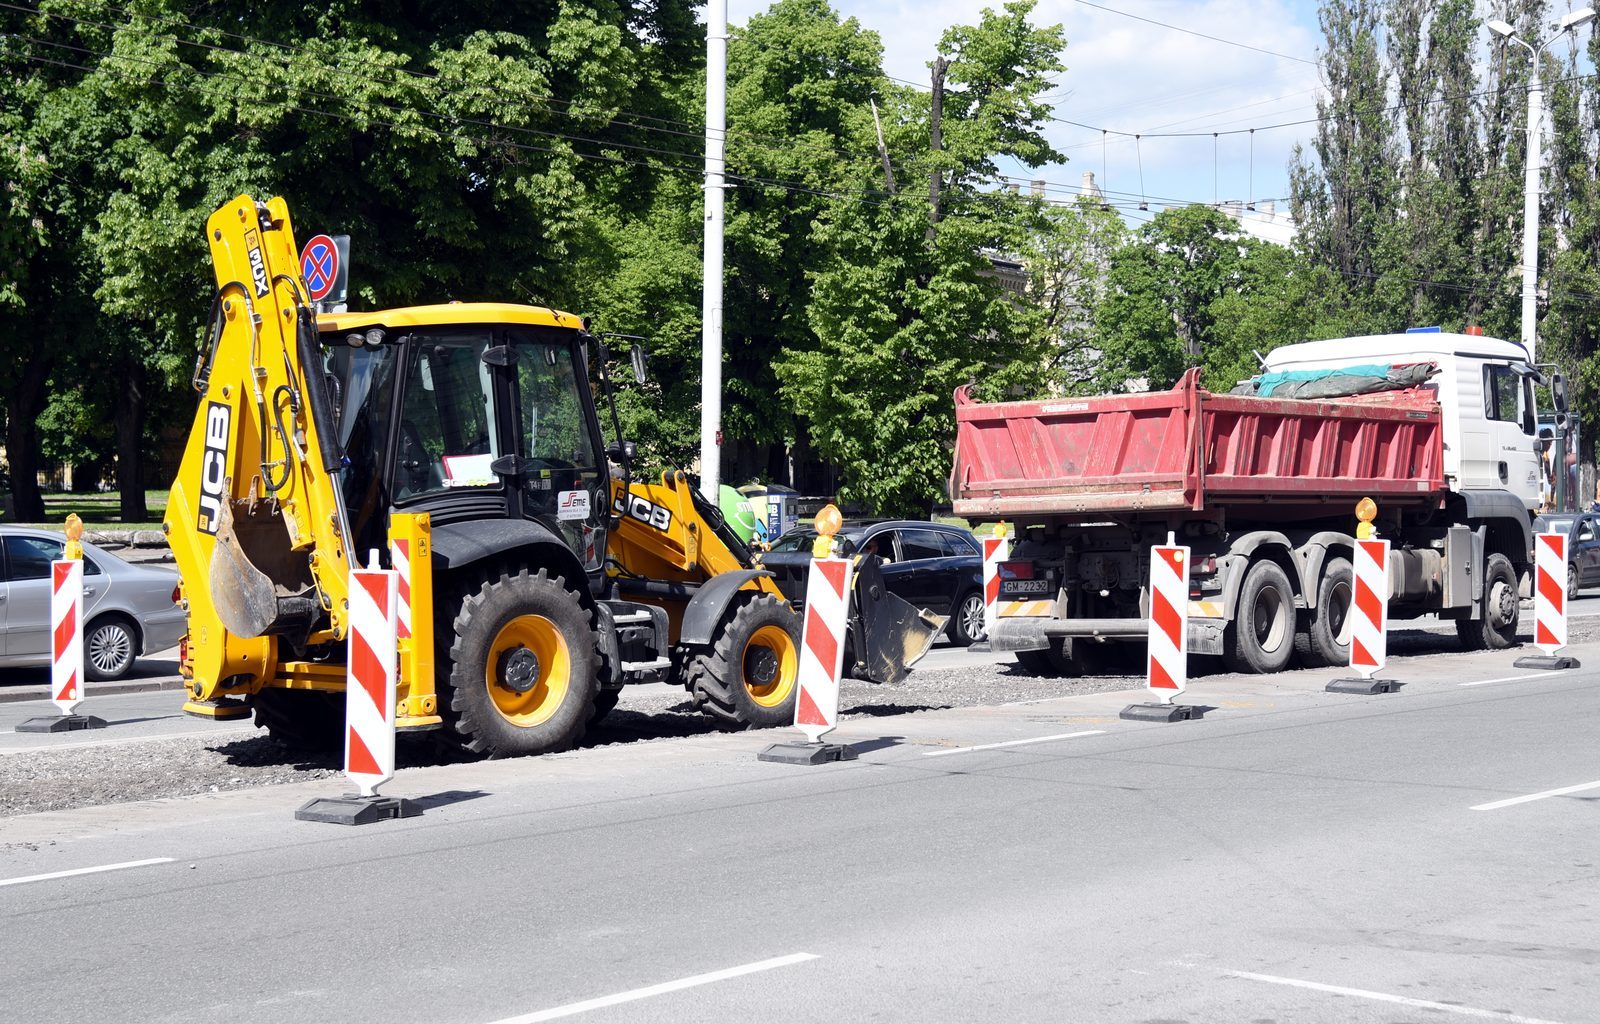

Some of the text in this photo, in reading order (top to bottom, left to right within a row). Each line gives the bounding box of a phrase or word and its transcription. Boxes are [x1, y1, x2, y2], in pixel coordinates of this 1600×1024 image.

[249, 248, 269, 296] 3CX
[201, 406, 230, 532] JCB
[615, 493, 671, 530] JCB
[1006, 581, 1047, 592] GM-2232
